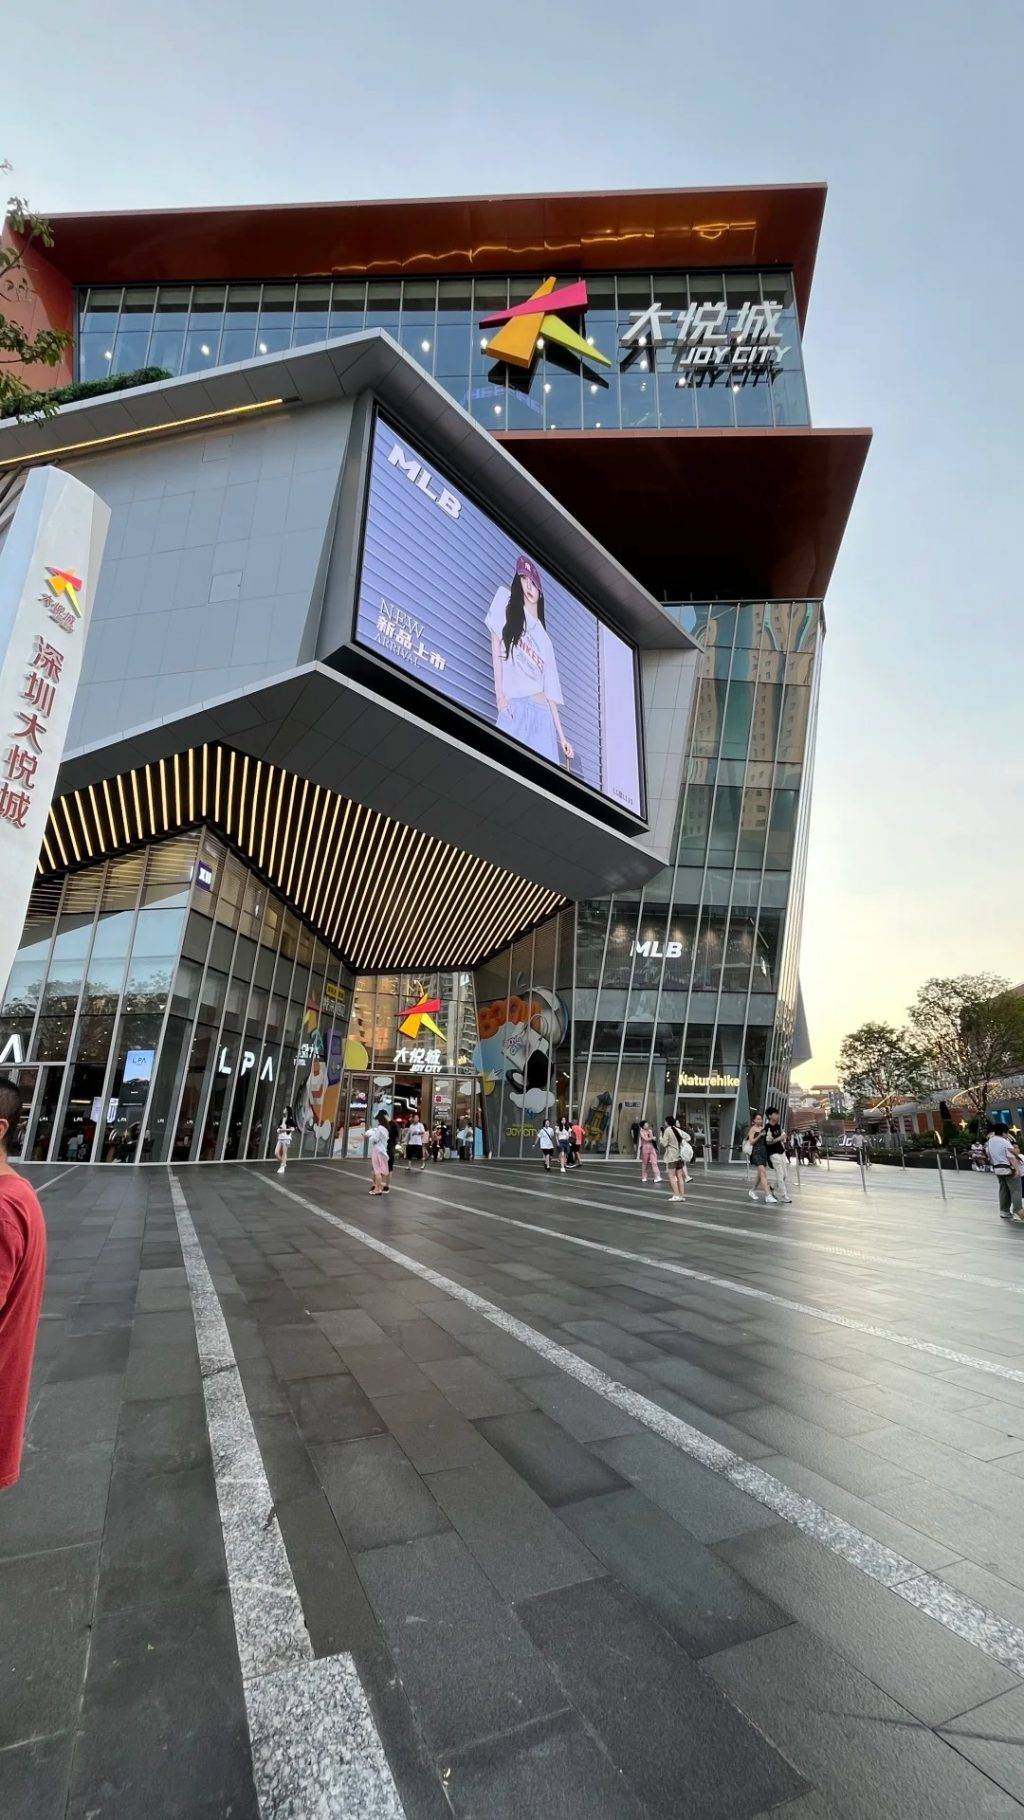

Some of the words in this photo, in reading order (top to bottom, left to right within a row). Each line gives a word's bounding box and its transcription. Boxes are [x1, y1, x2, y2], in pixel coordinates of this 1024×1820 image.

[620, 301, 784, 346] 大悦城
[680, 346, 731, 365] JOY
[732, 345, 792, 364] CITY
[387, 443, 462, 520] MLB
[379, 597, 425, 640] NEW
[376, 615, 447, 672] 新品上市
[0, 635, 65, 829] 深圳大悦城
[631, 941, 683, 959] MLB
[393, 1047, 442, 1065] 大悦城
[409, 1064, 425, 1072] JOY
[425, 1065, 442, 1073] CITY
[679, 1071, 740, 1088] Naturehike
